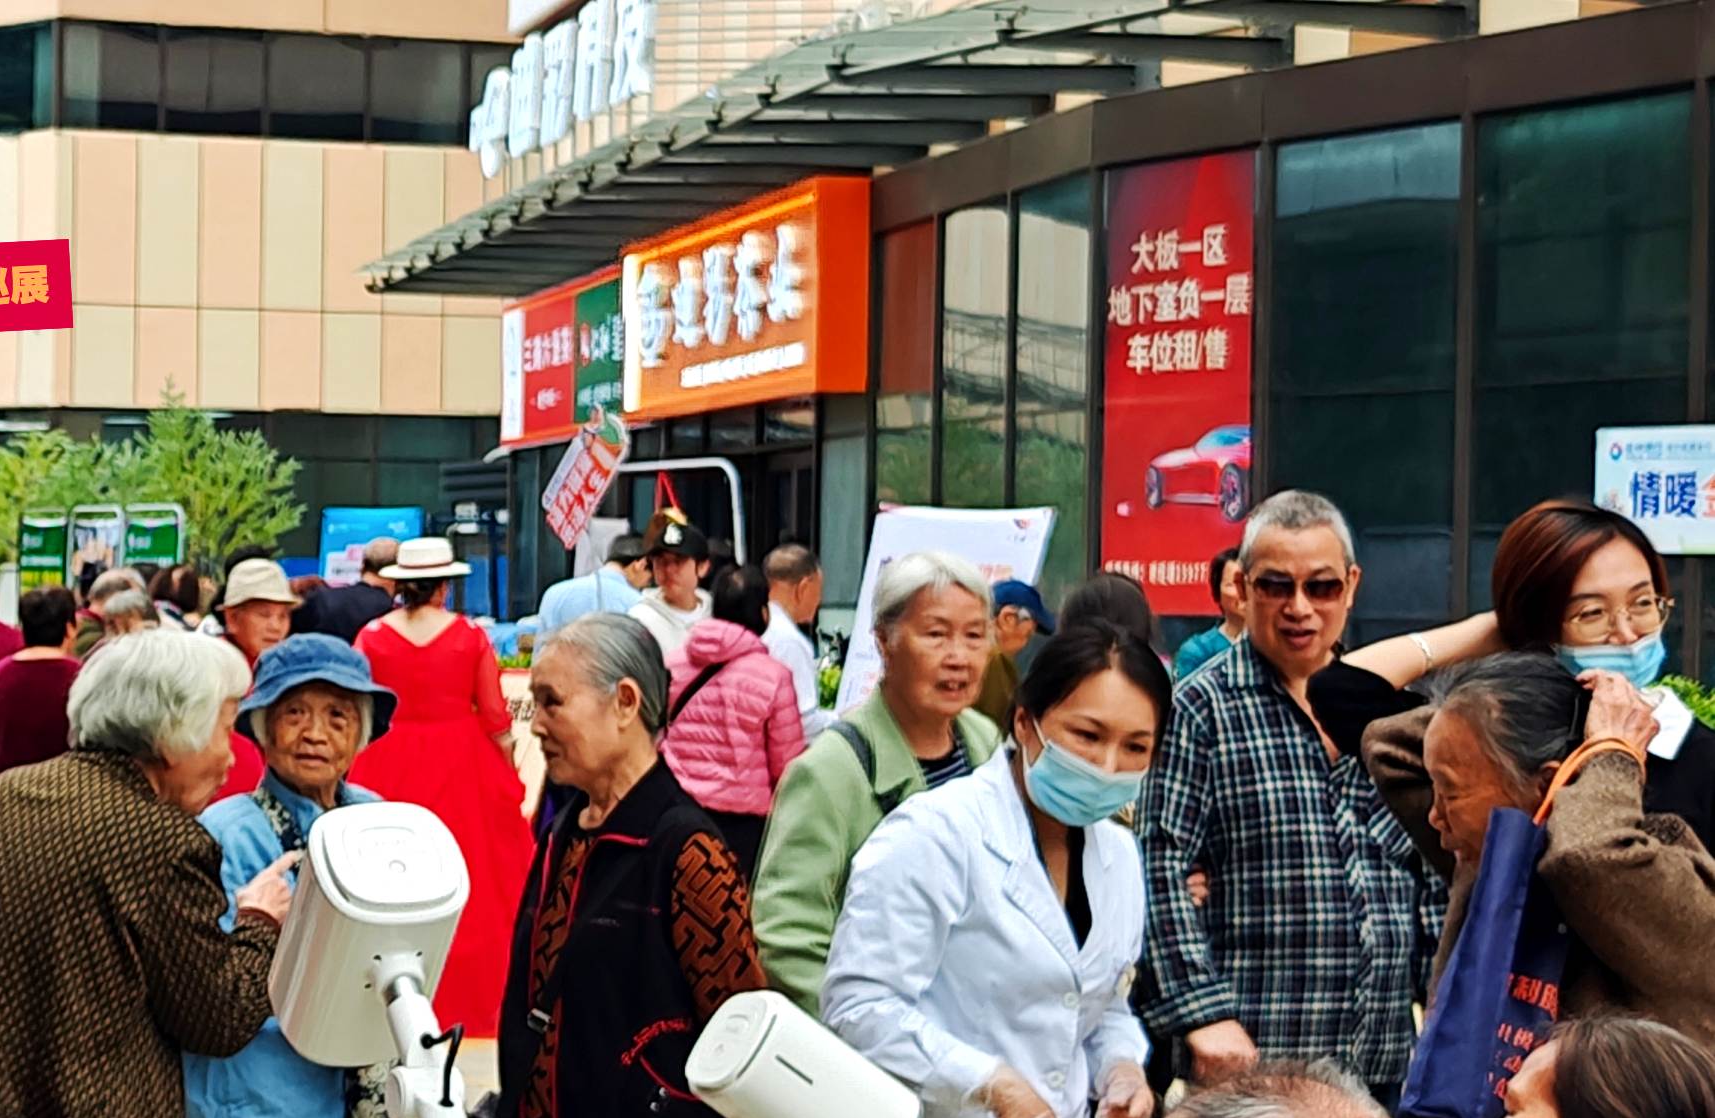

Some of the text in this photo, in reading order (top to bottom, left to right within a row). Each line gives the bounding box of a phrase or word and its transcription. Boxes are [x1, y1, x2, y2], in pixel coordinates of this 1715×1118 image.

[1131, 223, 1228, 274] 大板一区
[1108, 272, 1253, 326] 地下室负一层
[1126, 325, 1229, 375] 车位租/售
